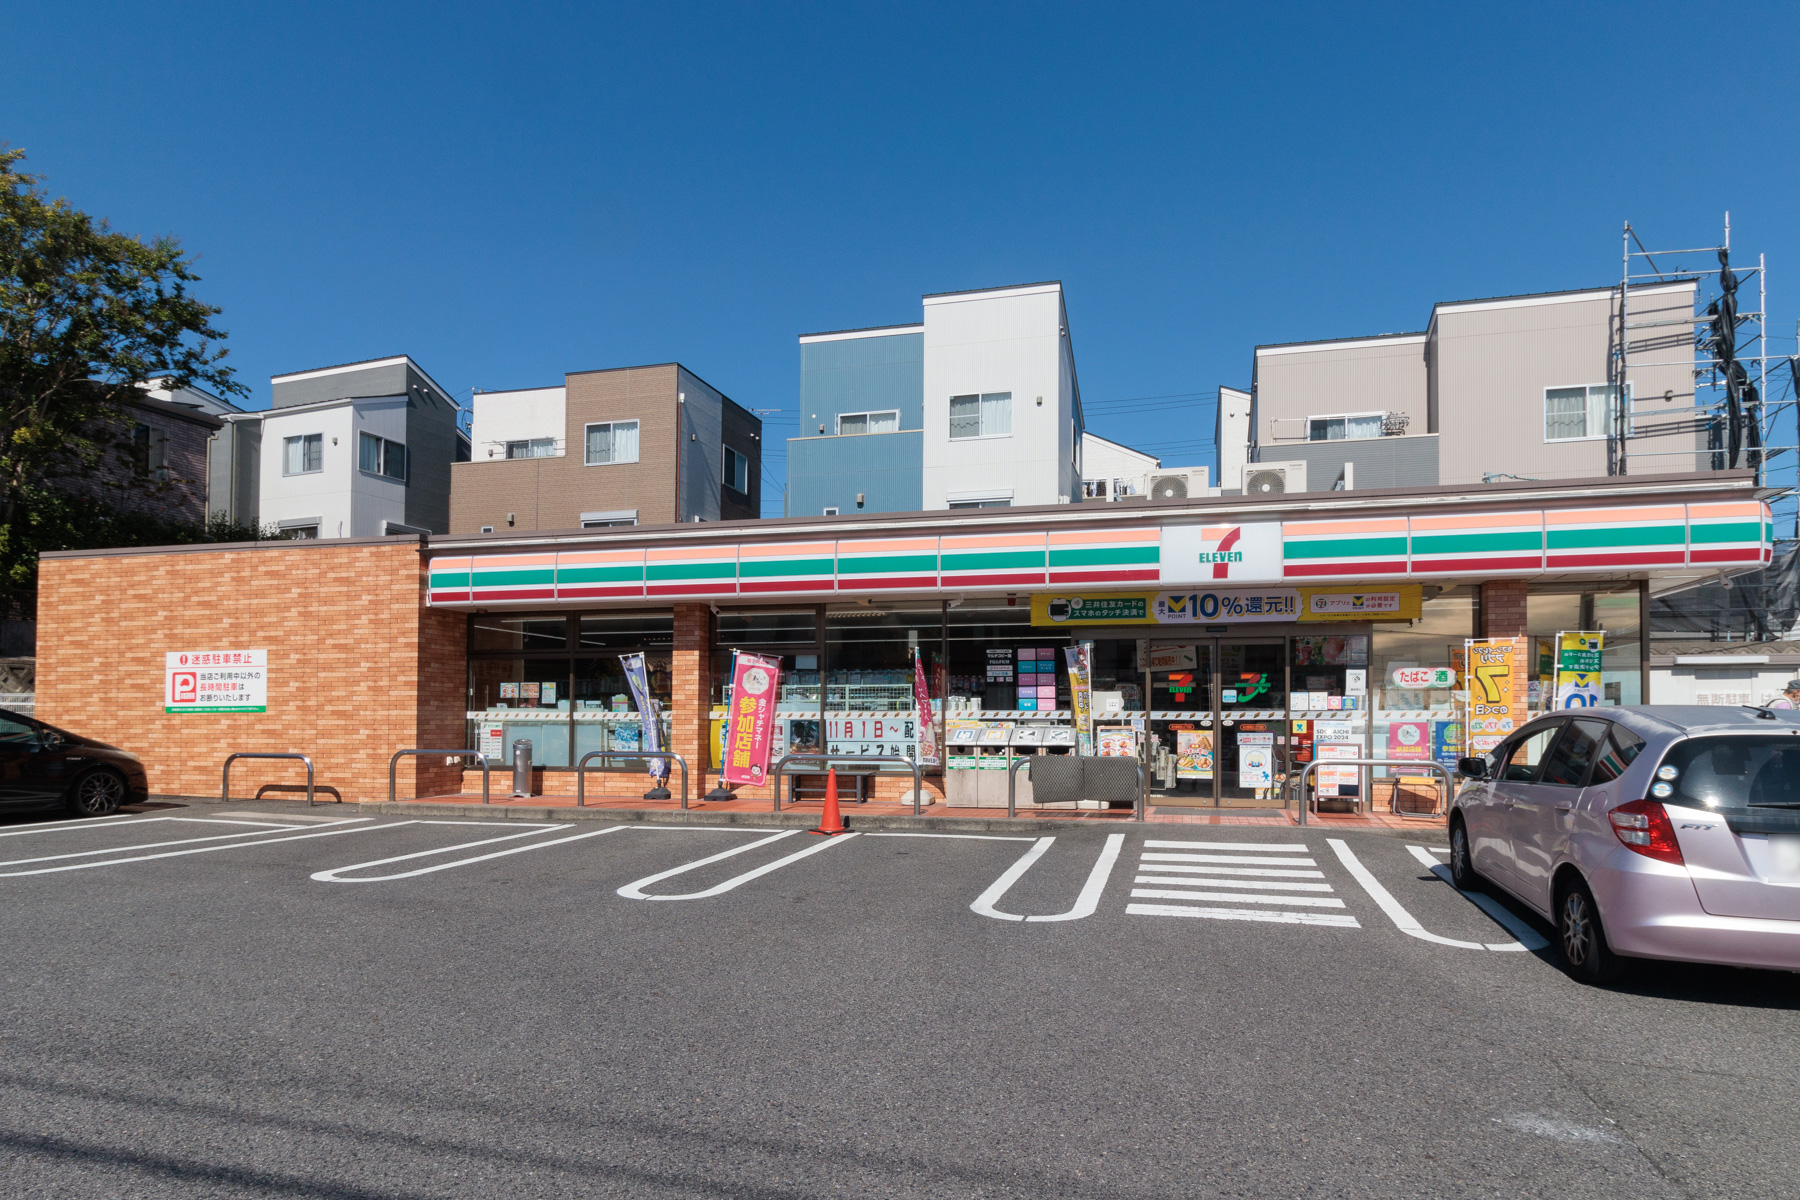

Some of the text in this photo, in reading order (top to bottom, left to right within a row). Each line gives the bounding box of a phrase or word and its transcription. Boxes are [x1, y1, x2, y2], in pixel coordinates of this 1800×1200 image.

[1085, 601, 1144, 609] 三井住友カードの
[1158, 601, 1166, 615] 最大
[1073, 609, 1145, 617] スマホのタッチ決済で
[191, 653, 253, 665] 迷惑駐車禁止
[200, 672, 261, 681] 当店ご利用中以外の
[1400, 671, 1448, 682] たばこ 酒
[200, 682, 245, 692] 長時間駐車は
[200, 693, 251, 702] お断りいたします
[754, 697, 767, 749] 金シャチマネー
[732, 696, 757, 769] 参加店舗
[1680, 823, 1718, 831] FIT
